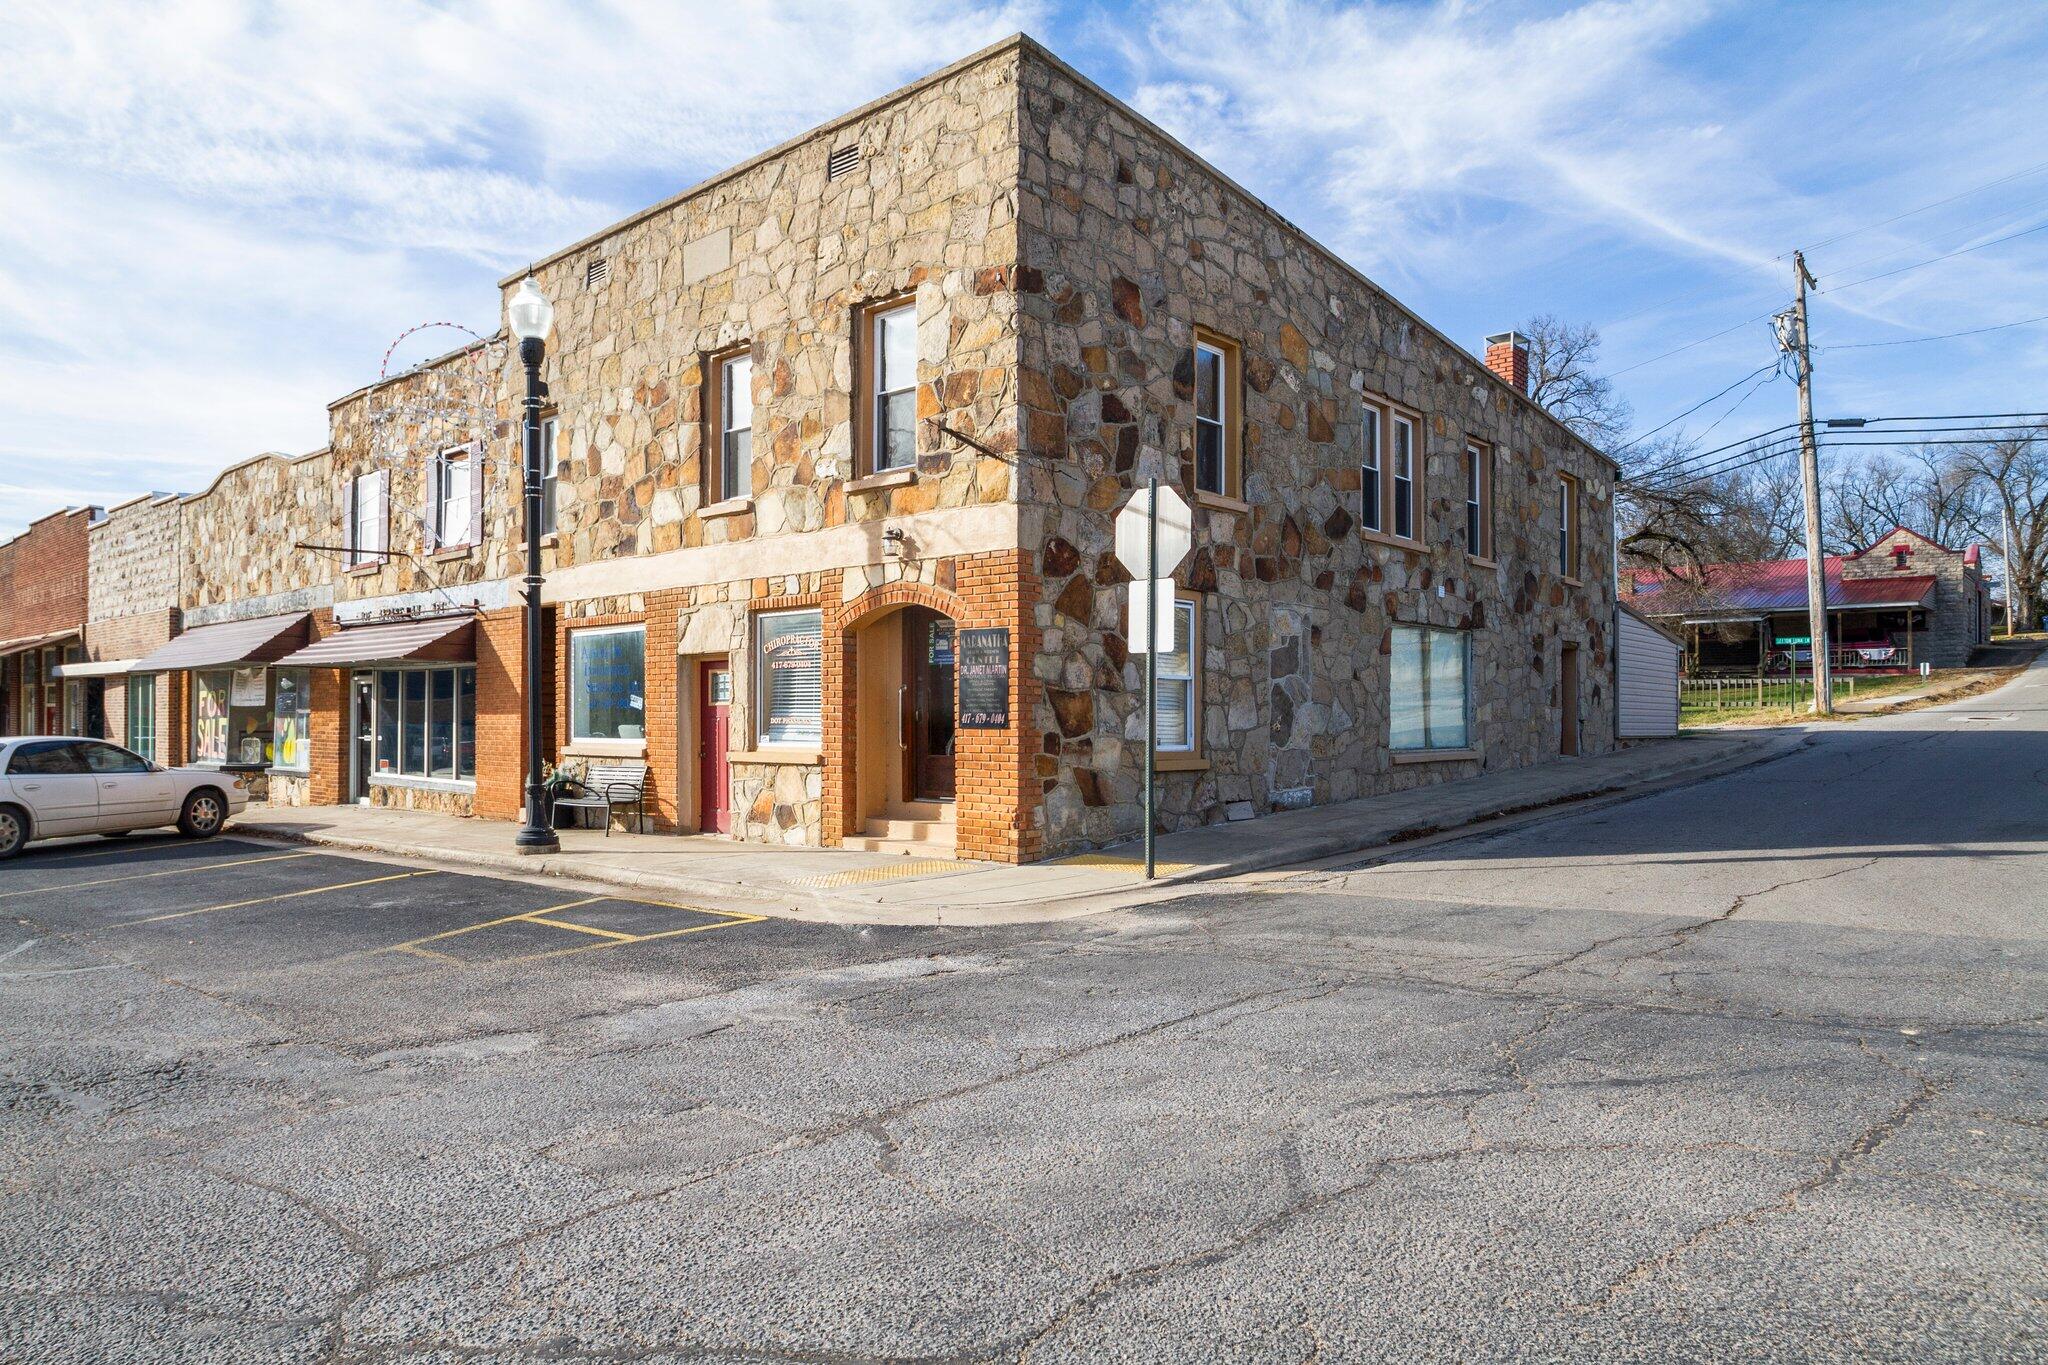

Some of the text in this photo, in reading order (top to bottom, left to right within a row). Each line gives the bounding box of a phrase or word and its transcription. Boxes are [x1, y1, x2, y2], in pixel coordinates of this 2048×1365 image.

[763, 634, 819, 654] CHIROPRACTOR
[986, 665, 1007, 675] MARTIN
[199, 690, 226, 717] FOR
[197, 717, 228, 759] SALE
